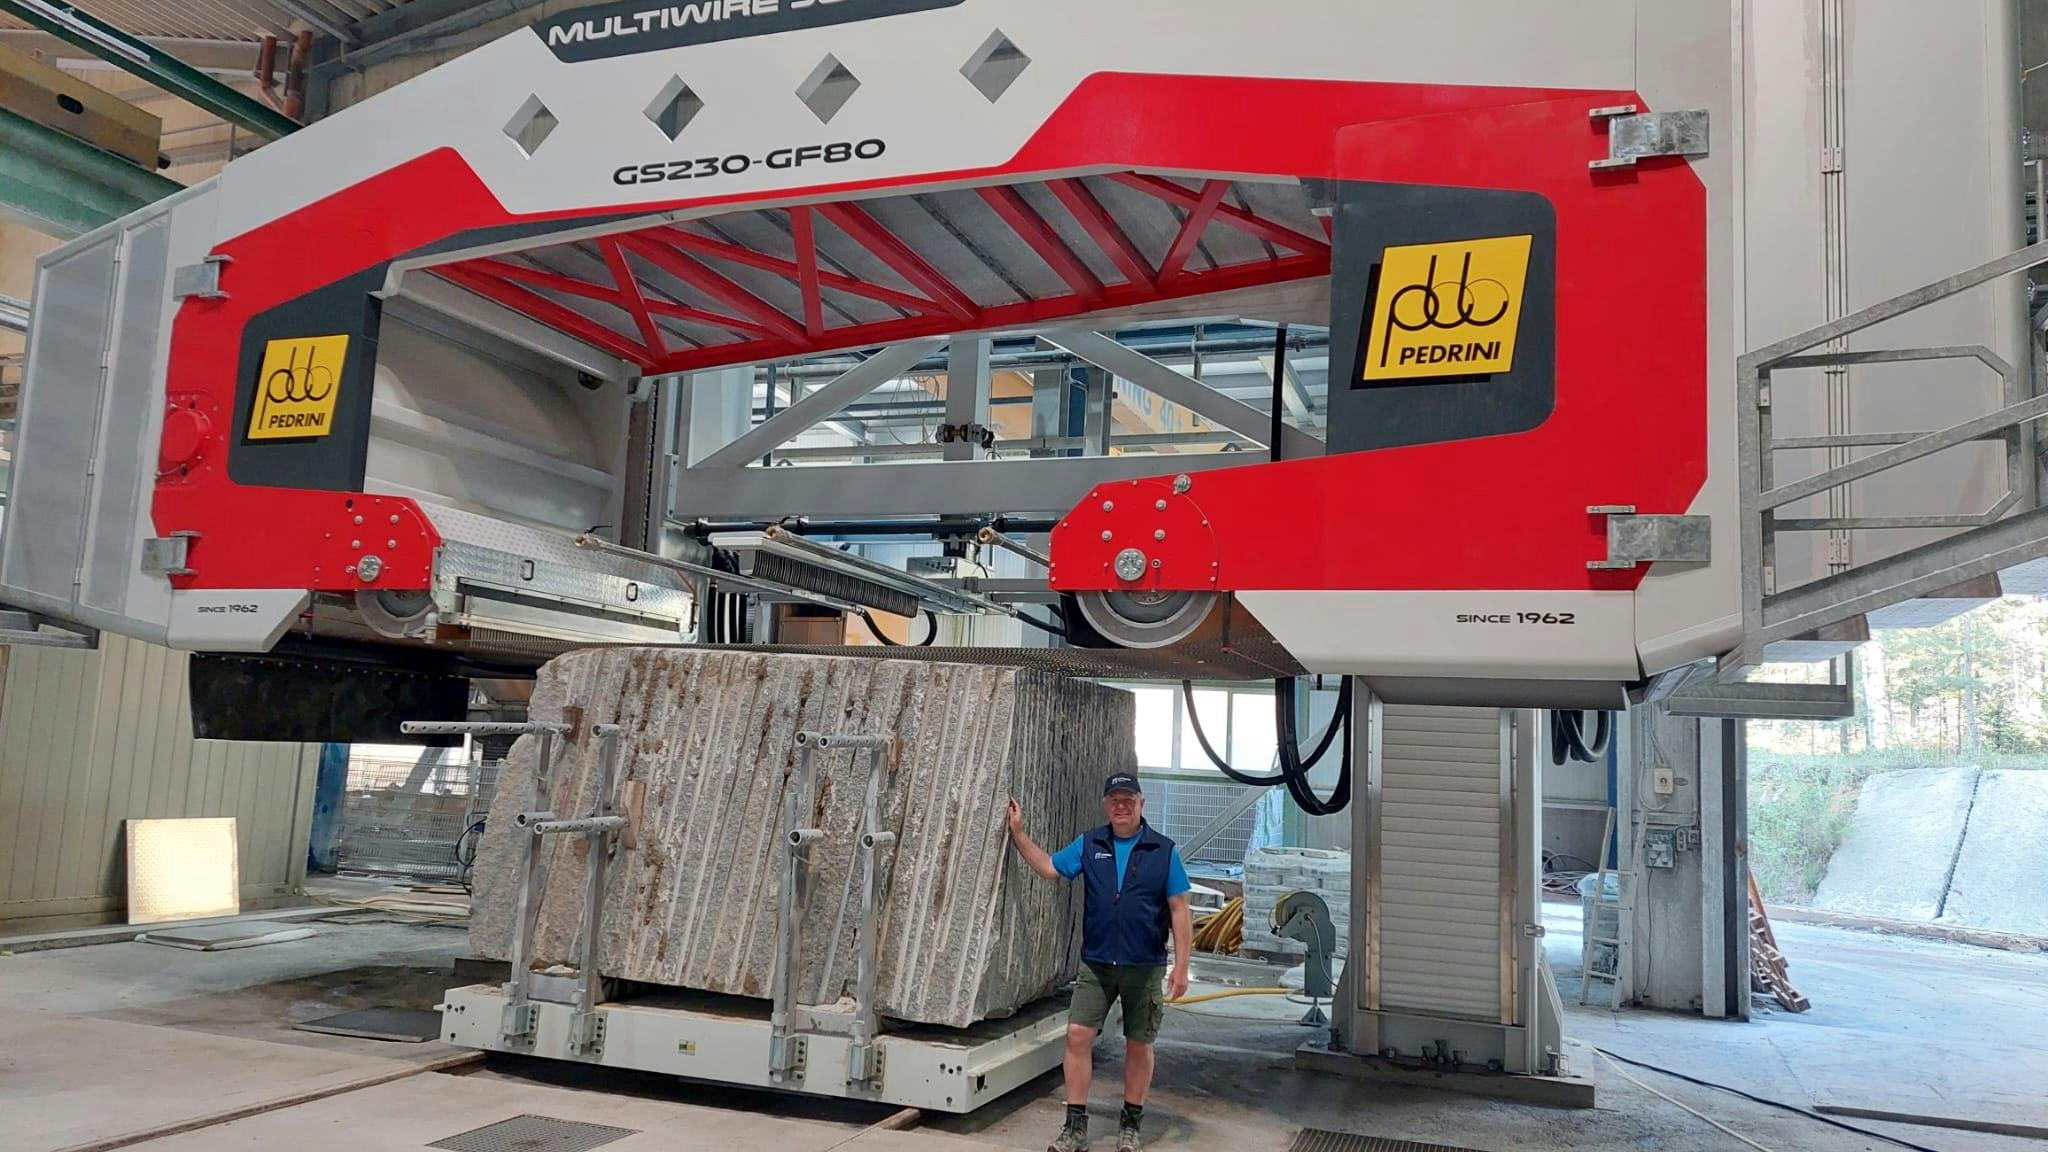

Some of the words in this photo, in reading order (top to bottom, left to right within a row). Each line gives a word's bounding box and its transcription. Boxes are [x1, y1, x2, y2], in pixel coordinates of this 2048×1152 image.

[548, 0, 779, 47] MULTIWIRE
[613, 138, 886, 185] GS230-GF80
[1399, 341, 1502, 365] PEDRINI
[269, 412, 325, 429] PEDRINI
[228, 604, 259, 613] 1962
[1456, 614, 1511, 624] SINCE
[1516, 612, 1576, 625] 1962
